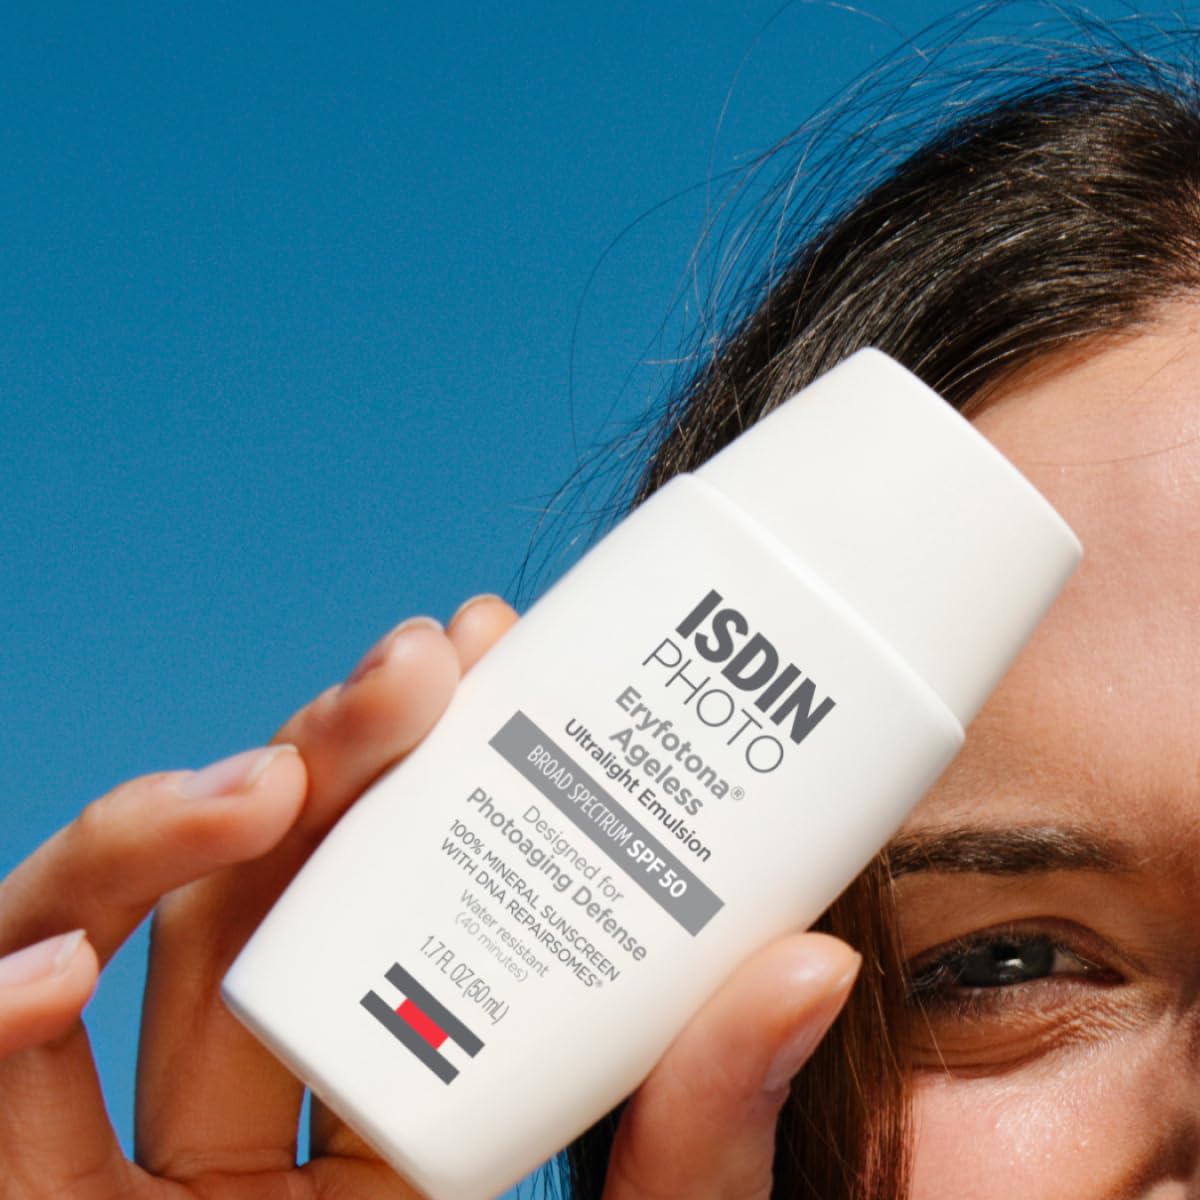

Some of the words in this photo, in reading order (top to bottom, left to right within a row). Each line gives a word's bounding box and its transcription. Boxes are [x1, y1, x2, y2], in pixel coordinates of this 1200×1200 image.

[641, 637, 785, 774] PHOTO
[674, 588, 837, 746] ISDIN
[526, 744, 574, 790] BROAD
[567, 783, 634, 847] SPECTRUM
[626, 839, 667, 873] SPF
[658, 868, 688, 898] 50
[564, 717, 640, 794] Ultralight
[636, 787, 712, 863] Emulsion
[608, 727, 704, 817] Ageless
[441, 836, 479, 876] WITH
[474, 870, 507, 905] DNA
[449, 818, 486, 856] 100%
[481, 849, 540, 911] MINERAL
[539, 904, 621, 983] SUNSCREEN
[466, 786, 574, 893] Photoaging
[570, 884, 648, 962] Defense
[521, 804, 602, 881] Designed
[596, 875, 625, 903] for
[419, 935, 447, 959] 1.7
[434, 949, 456, 975] FL
[481, 996, 511, 1026] mL)
[454, 911, 481, 936] (40
[476, 933, 529, 984] minutes)
[460, 888, 499, 928] Water
[495, 926, 550, 979] resistant
